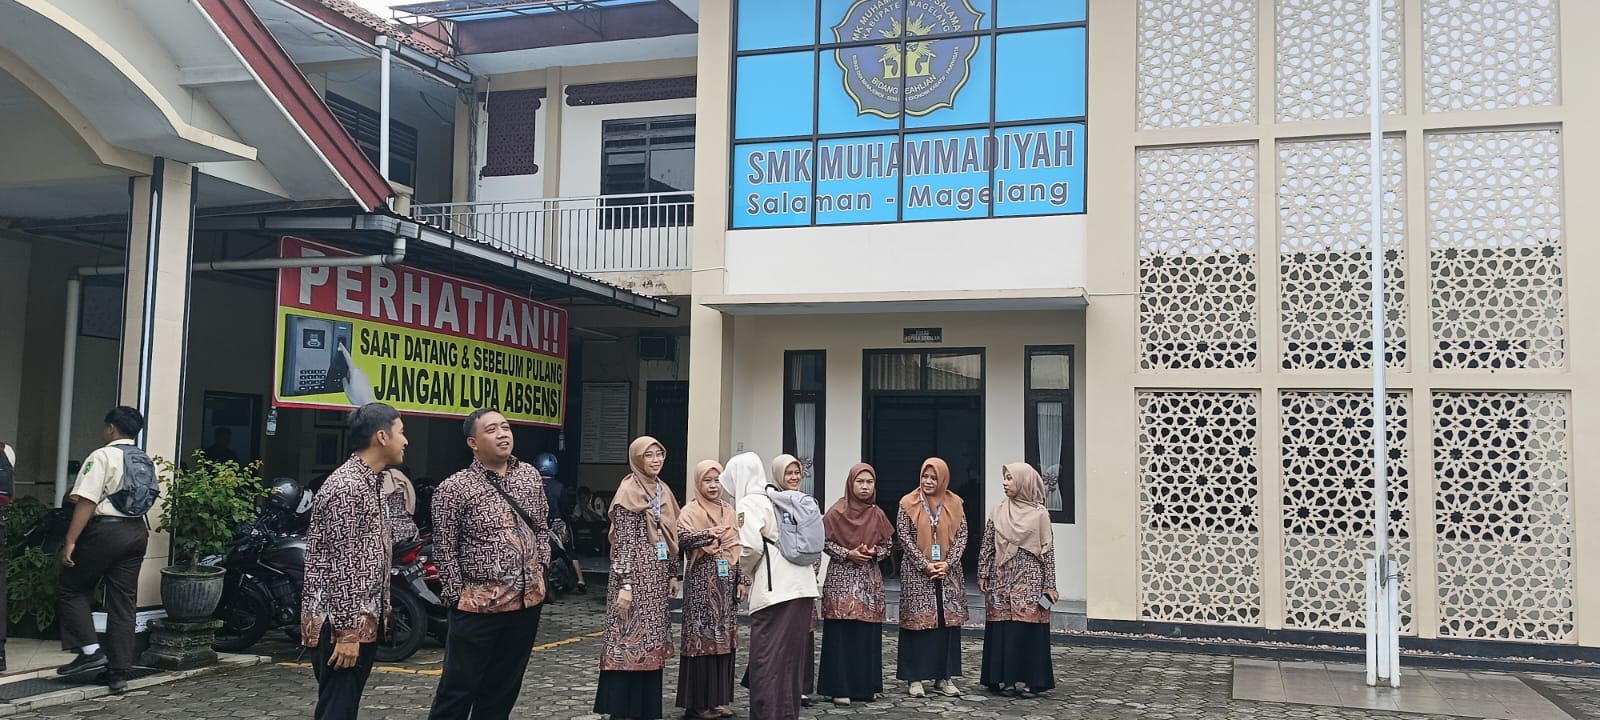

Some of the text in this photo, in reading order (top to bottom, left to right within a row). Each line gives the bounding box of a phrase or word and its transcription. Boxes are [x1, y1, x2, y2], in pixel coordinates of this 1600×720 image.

[862, 1, 950, 39] KABUPATE MAGELANG
[934, 0, 961, 32] SALAMA
[871, 74, 937, 95] BIDANG EAHLIAN
[747, 130, 1075, 185] SMK MUHAMMADIYAH
[746, 190, 872, 215] Salaman
[908, 180, 1069, 211] Magelang
[299, 247, 559, 354] PERHATIAN!!
[360, 327, 563, 385] SAAT DATANG & SEBELUM PULANG
[374, 364, 562, 418] JANGAN LUPA ABSENSI
